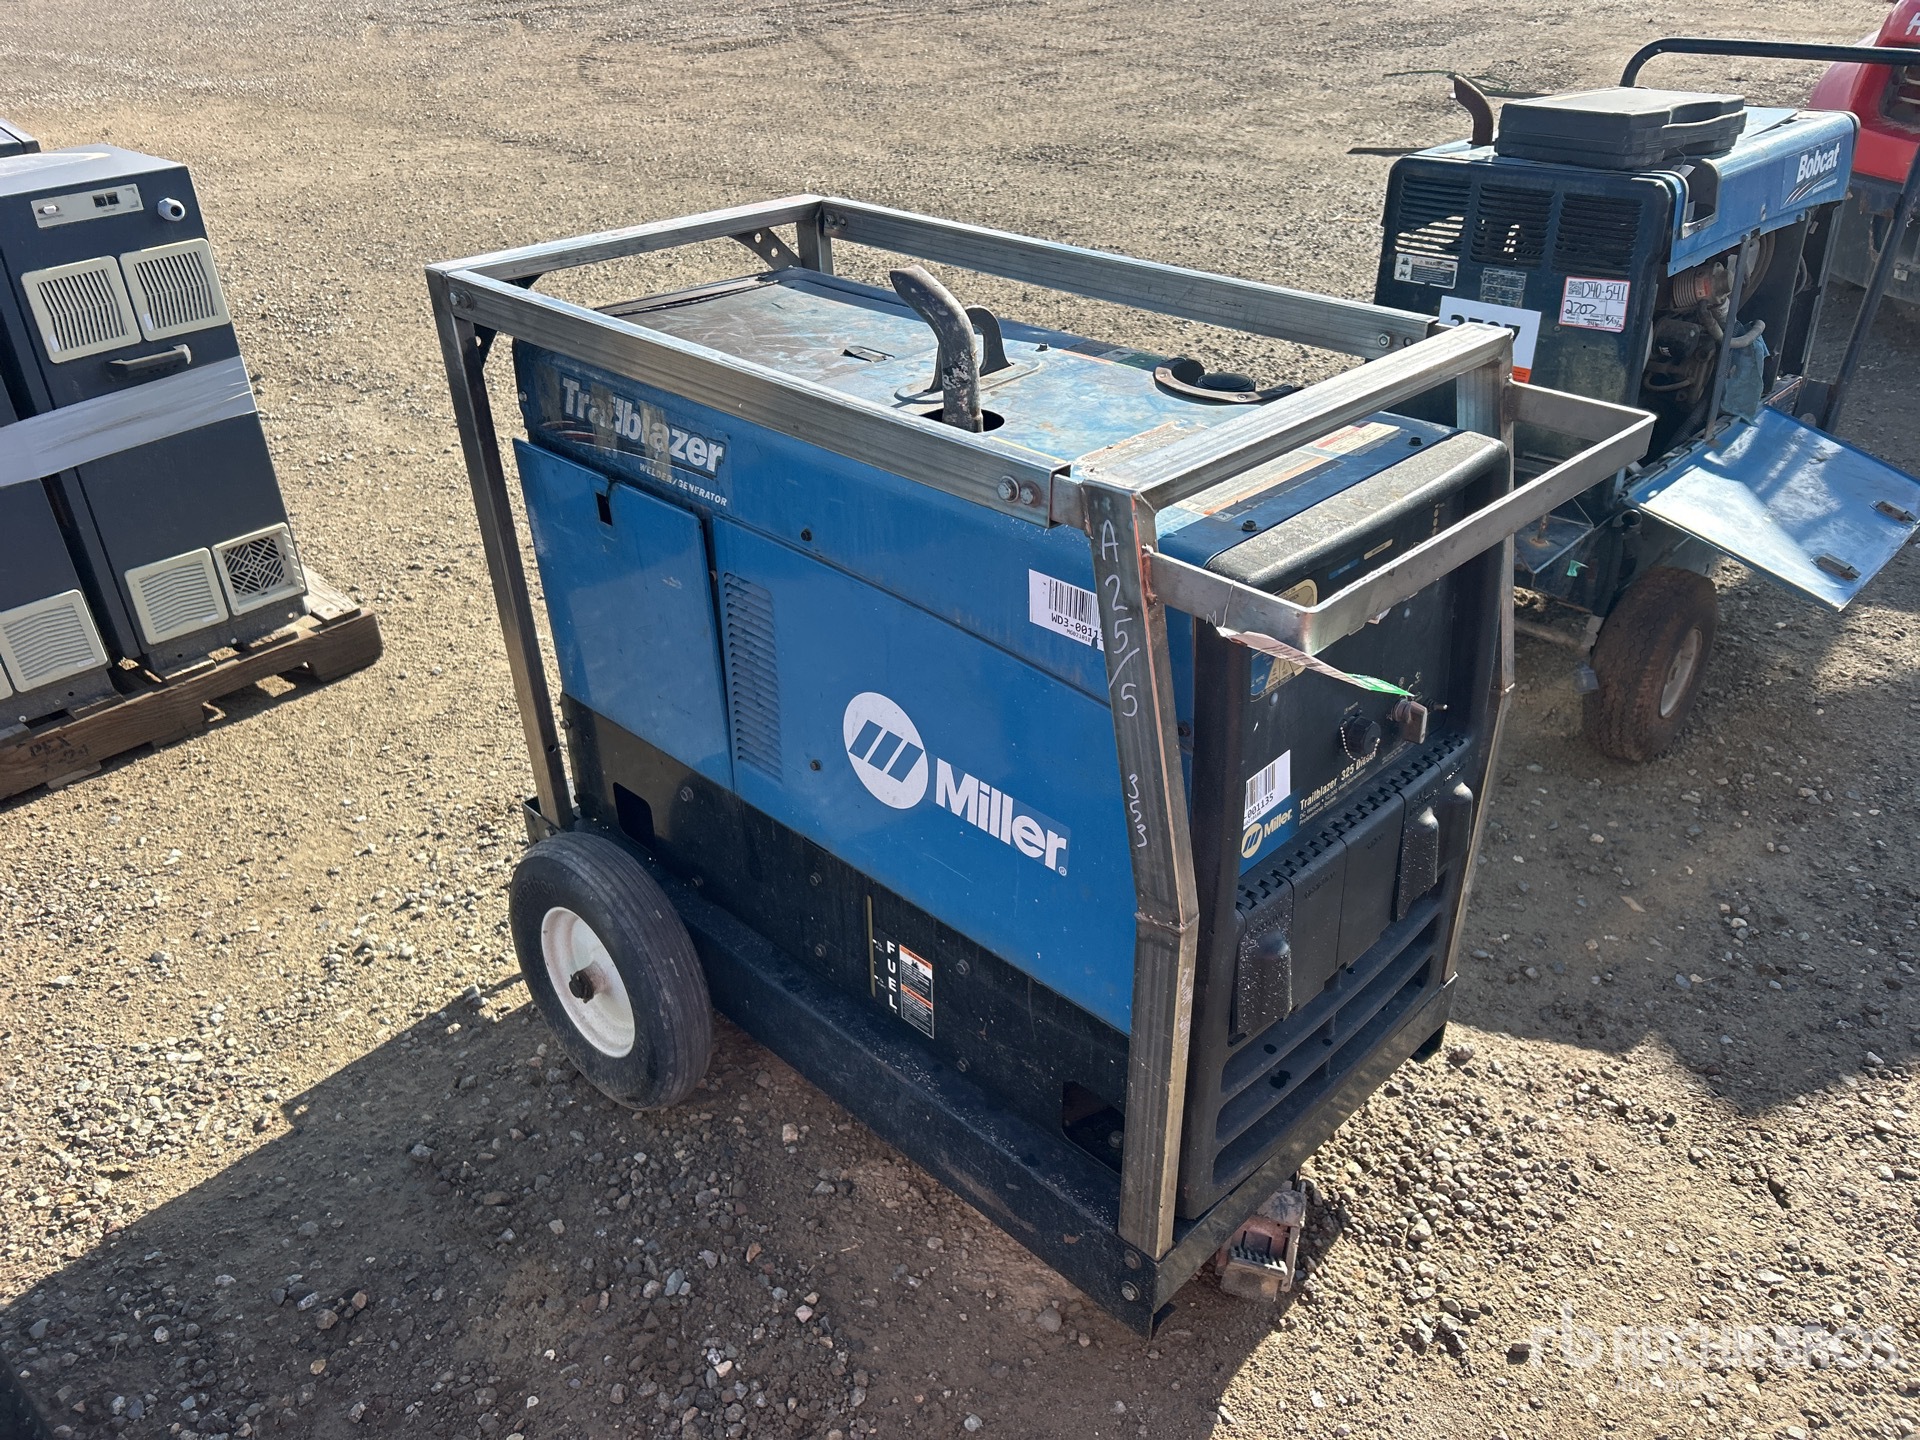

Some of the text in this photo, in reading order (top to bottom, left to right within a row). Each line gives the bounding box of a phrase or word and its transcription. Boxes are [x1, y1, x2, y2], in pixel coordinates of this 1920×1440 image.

[1796, 142, 1840, 183] Bobcat
[562, 376, 724, 473] Trailblazer
[638, 462, 728, 507] WELDER/GENERATOR
[1299, 777, 1338, 811] Trailblazer
[1340, 762, 1355, 782] 325
[935, 757, 1068, 873] Miller
[1263, 808, 1292, 838] Miller
[886, 940, 899, 1011] FUEL
